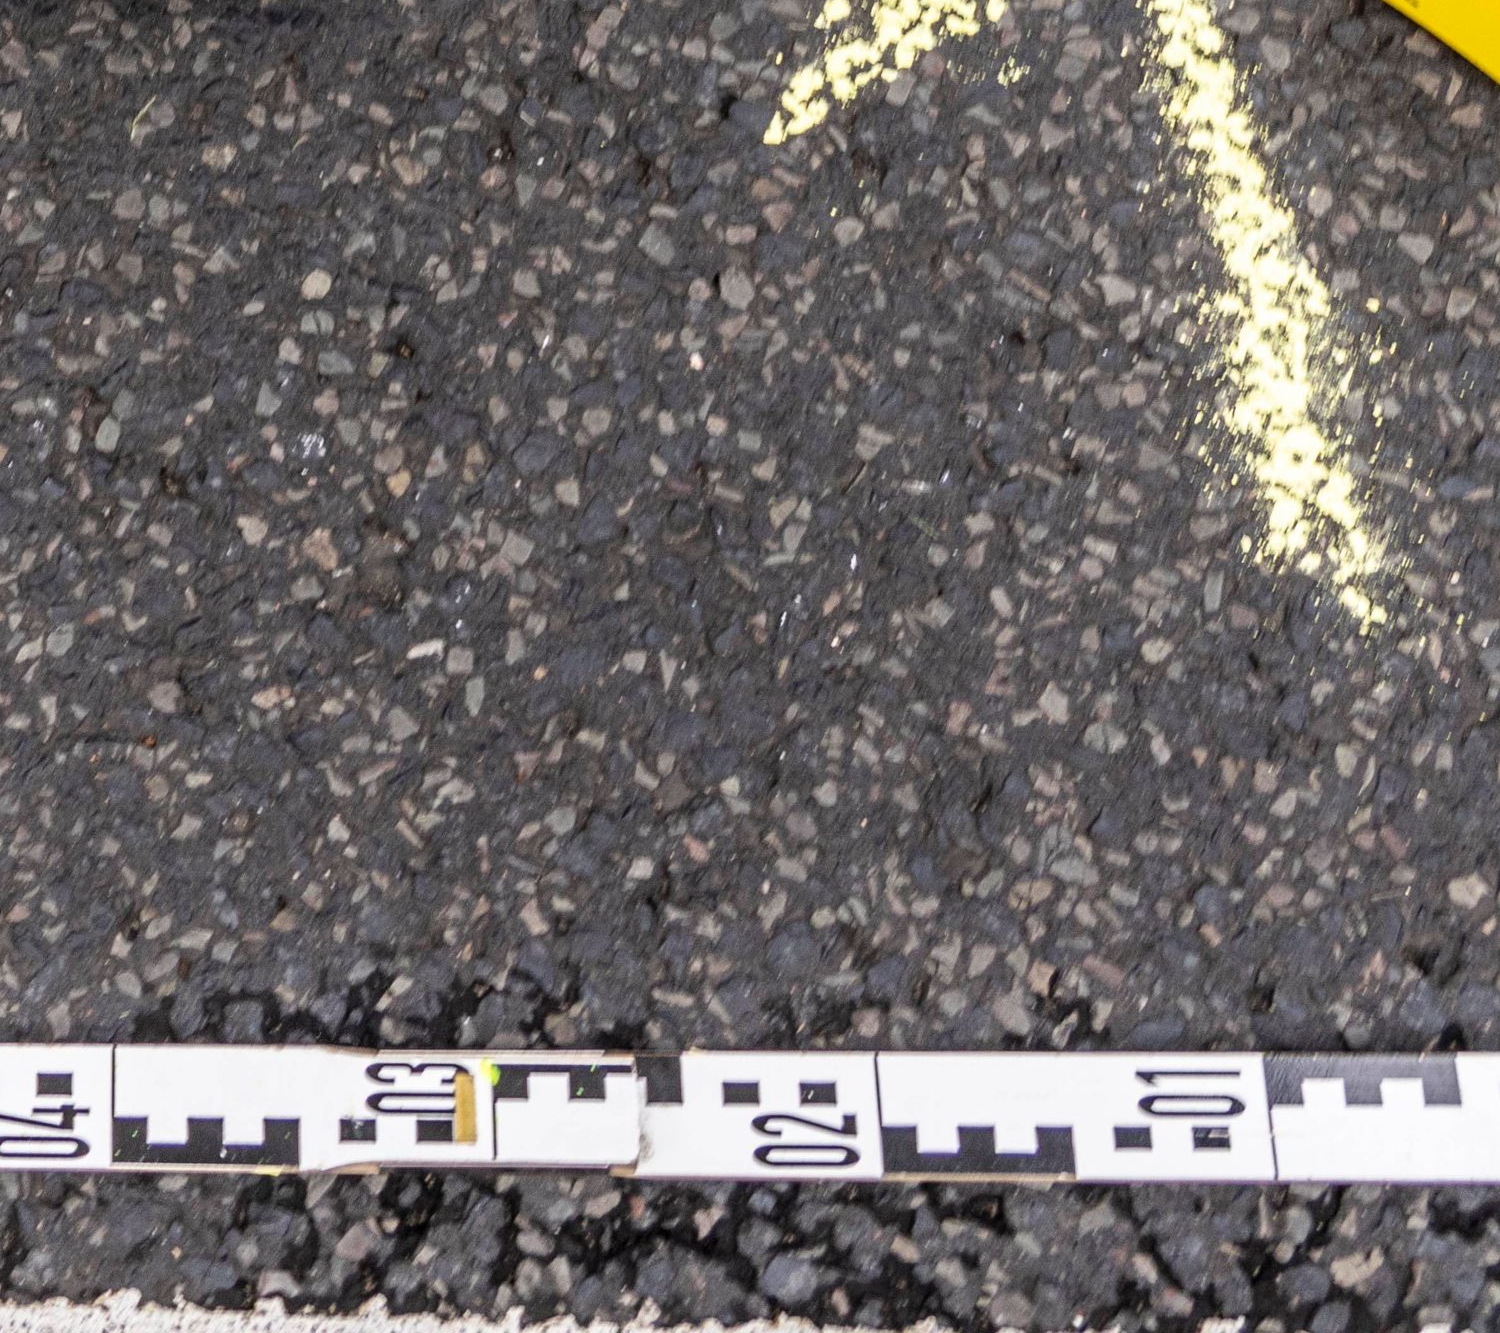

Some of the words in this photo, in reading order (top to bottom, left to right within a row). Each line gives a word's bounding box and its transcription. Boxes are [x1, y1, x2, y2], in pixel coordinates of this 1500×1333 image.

[365, 1062, 471, 1114] 03
[1136, 1069, 1245, 1116] 01
[751, 1113, 860, 1167] 02
